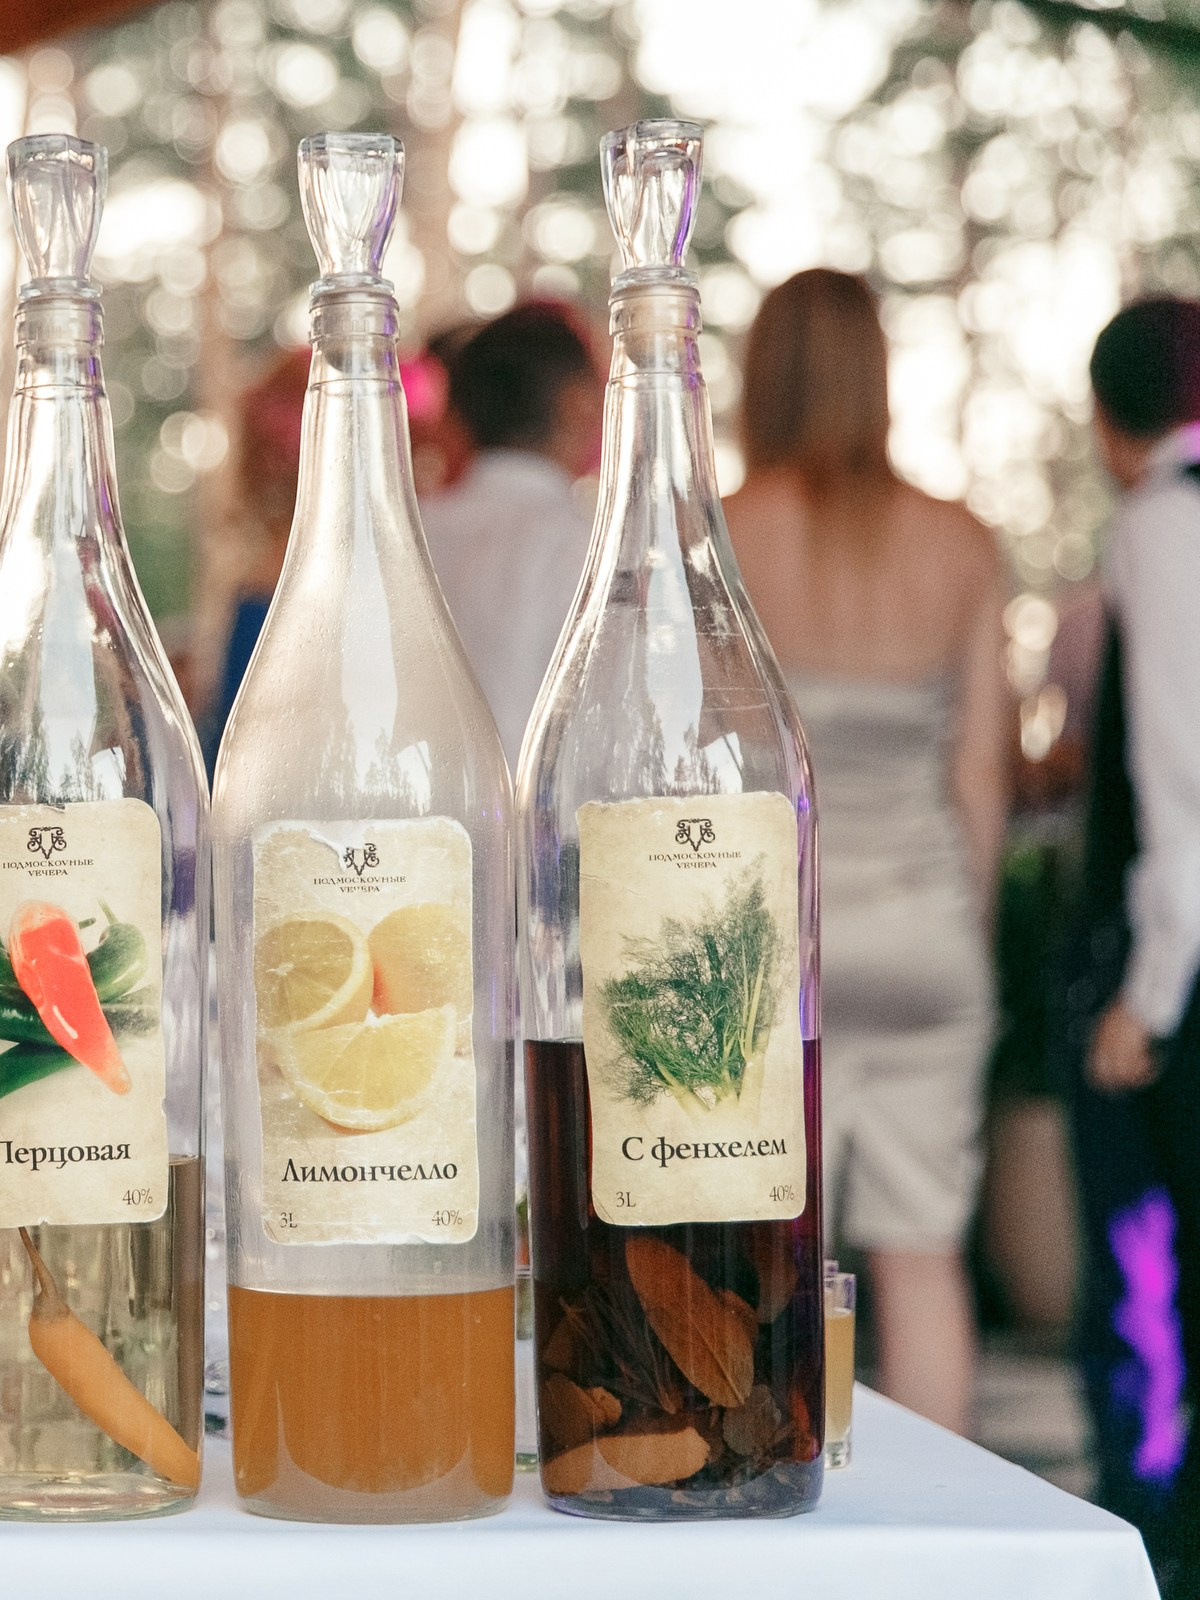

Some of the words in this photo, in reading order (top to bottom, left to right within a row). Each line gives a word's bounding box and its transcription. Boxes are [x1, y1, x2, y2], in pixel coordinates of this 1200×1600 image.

[621, 1136, 644, 1161] С
[651, 1136, 788, 1168] фенхелем
[281, 1158, 458, 1182] Лимончелло
[122, 1189, 154, 1206] 40%
[616, 1191, 636, 1208] 3L
[769, 1184, 795, 1202] 40%
[431, 1210, 464, 1227] 40%
